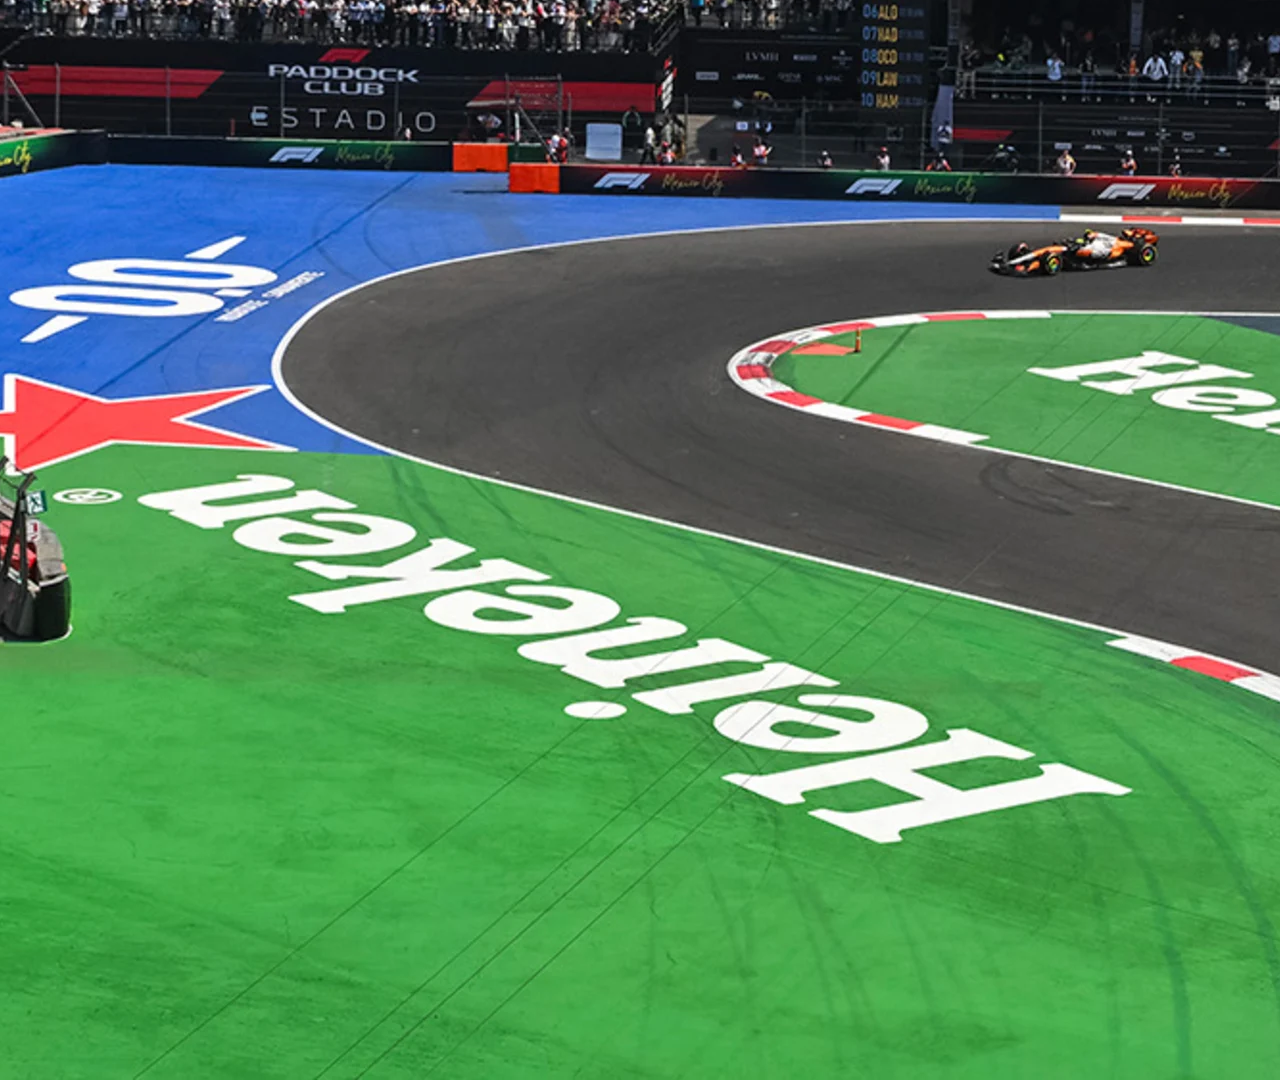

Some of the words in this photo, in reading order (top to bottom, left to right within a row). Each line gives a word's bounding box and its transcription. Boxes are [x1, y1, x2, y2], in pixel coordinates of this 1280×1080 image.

[878, 5, 898, 20] ALO
[269, 64, 419, 82] PADDOCK
[304, 80, 385, 97] CLUB
[252, 106, 436, 132] ESTADIO
[137, 474, 1133, 844] Heineken
